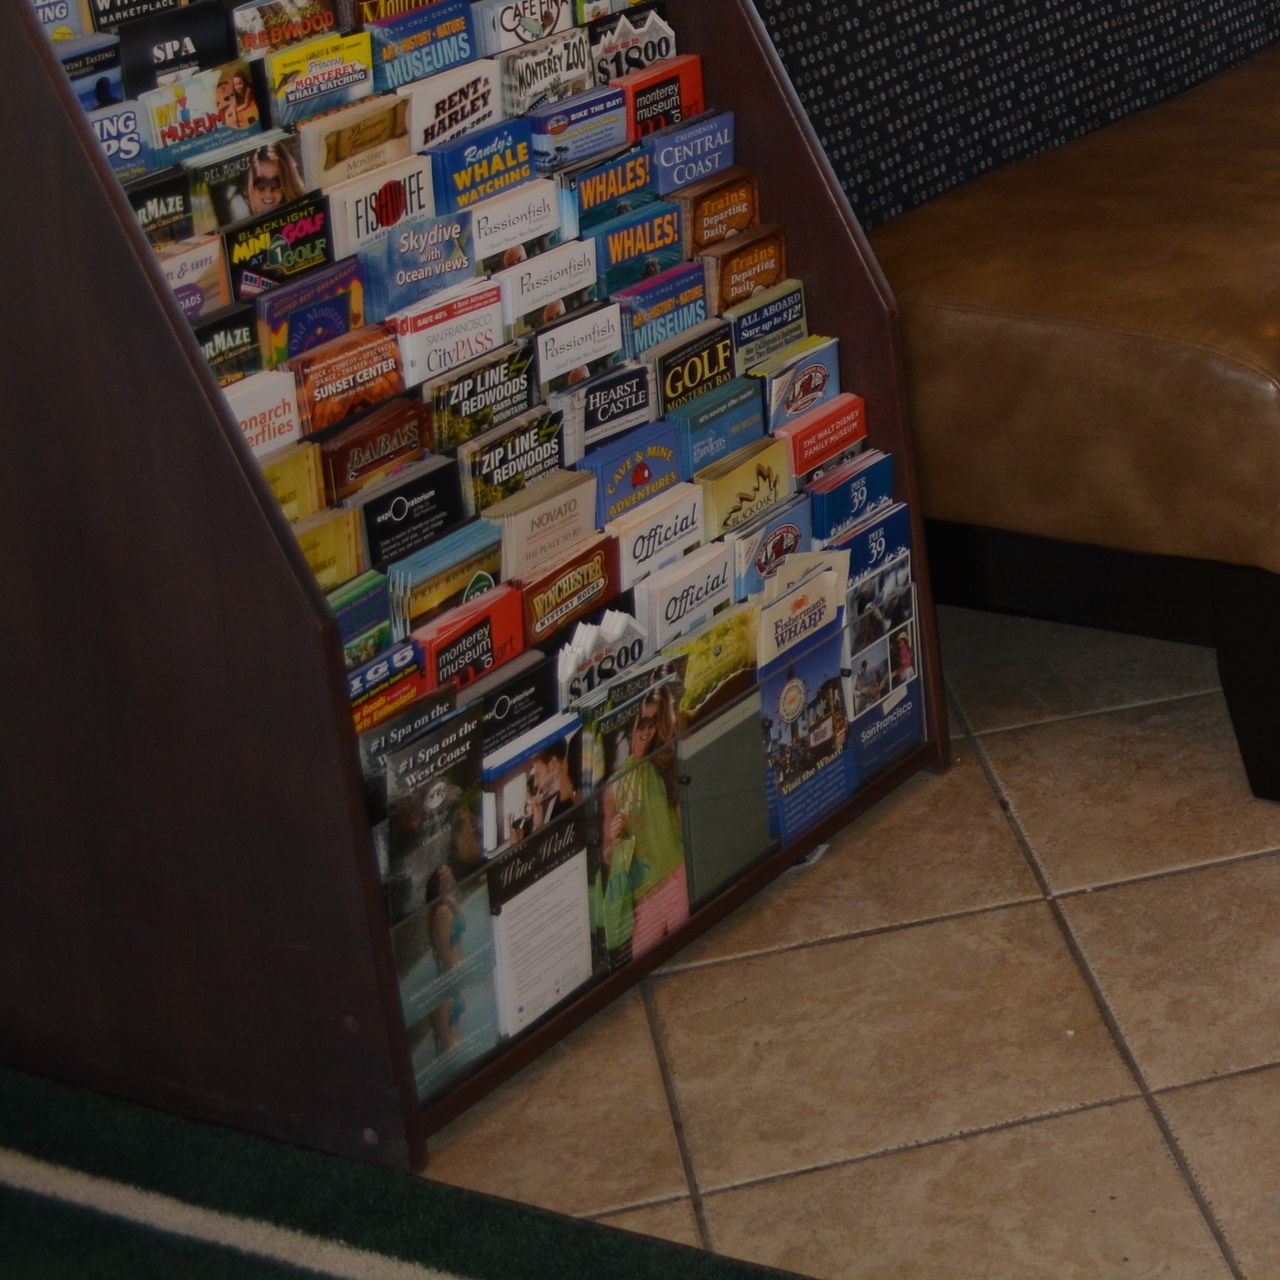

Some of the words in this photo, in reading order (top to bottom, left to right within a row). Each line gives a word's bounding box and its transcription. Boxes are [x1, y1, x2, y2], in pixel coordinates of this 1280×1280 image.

[436, 17, 466, 38] NATURE
[631, 36, 640, 47] to
[153, 36, 196, 65] SPA
[385, 32, 471, 89] MUSEUMS
[517, 51, 563, 97] MONTEREY
[563, 36, 586, 71] ZOO
[287, 84, 319, 102] WHALE
[320, 70, 366, 92] WATCHING
[295, 63, 357, 89] MONTEREY
[434, 78, 481, 119] RENT
[571, 109, 589, 121] BIKE
[590, 104, 604, 116] THE
[636, 82, 680, 109] monterey
[636, 95, 681, 122] museum
[160, 109, 228, 147] MUSEUM
[423, 90, 491, 146] HARLEY
[453, 142, 529, 190] WHALE
[464, 131, 514, 165] Randy's
[660, 129, 732, 168] CENTRAL
[456, 166, 531, 207] WATCHING
[580, 154, 651, 210] WHALES!
[673, 151, 722, 186] COAST
[477, 197, 552, 240] Passionfish
[703, 188, 747, 215] Trains
[703, 201, 749, 228] Departing
[233, 231, 271, 264] MINI
[281, 213, 325, 244] GOLF
[238, 206, 316, 242] BLACKLIGHT
[400, 222, 461, 255] Skydive
[608, 212, 679, 266] WHALES!
[703, 223, 728, 241] Daily
[282, 238, 327, 268] GOLF
[395, 265, 433, 286] Ocean
[434, 255, 470, 276] views
[419, 248, 442, 264] with
[731, 244, 775, 272] Trains
[731, 258, 776, 285] Departing
[520, 251, 592, 296] Passionfish
[731, 280, 755, 298] Daily
[443, 313, 493, 343] FRANCISCO
[634, 300, 706, 353] MUSEUMS
[741, 312, 760, 328] ALL
[763, 293, 801, 313] ABOARD
[426, 328, 495, 373] CityPASS
[545, 318, 616, 361] Passionfish
[314, 375, 356, 402] SUNSET
[356, 358, 397, 384] CENTER
[450, 379, 473, 406] ZIP
[477, 363, 511, 394] LINE
[664, 338, 732, 399] GOLF
[461, 373, 529, 417] REDWOODS
[492, 398, 511, 413] SANTA
[511, 391, 528, 406] CRUZ
[588, 377, 640, 412] HEARST
[597, 389, 647, 422] CASTLE
[666, 379, 715, 412] MONTEREY
[715, 371, 734, 389] BAY
[803, 435, 816, 449] THE
[817, 423, 836, 442] WALT
[836, 409, 860, 432] DISNEY
[804, 441, 828, 459] FAMILY
[829, 422, 858, 447] MUSEUM
[482, 446, 503, 474] ZIP
[507, 428, 540, 456] LINE
[493, 438, 559, 486] REDWOODS
[647, 446, 675, 462] MINE
[608, 471, 677, 517] ADVENTURES
[850, 488, 868, 513] 39
[851, 477, 867, 493] PIER
[531, 498, 578, 532] NOVATO
[633, 503, 698, 565] Official
[868, 527, 885, 544] PIER
[868, 538, 886, 564] 39
[533, 552, 603, 617] WINCHESTER
[665, 562, 728, 625] Official
[539, 599, 575, 626] MYSTERY
[576, 582, 603, 605] HOUSE
[439, 624, 490, 668] monterey
[774, 604, 827, 650] WHARF
[393, 645, 415, 668] 5
[439, 638, 491, 683] museum
[389, 724, 412, 744] Spa
[413, 715, 430, 729] on
[431, 701, 450, 719] the
[417, 743, 441, 765] Spa
[441, 732, 458, 748] on
[458, 719, 478, 736] the
[404, 763, 435, 787] West
[437, 740, 472, 767] Coast
